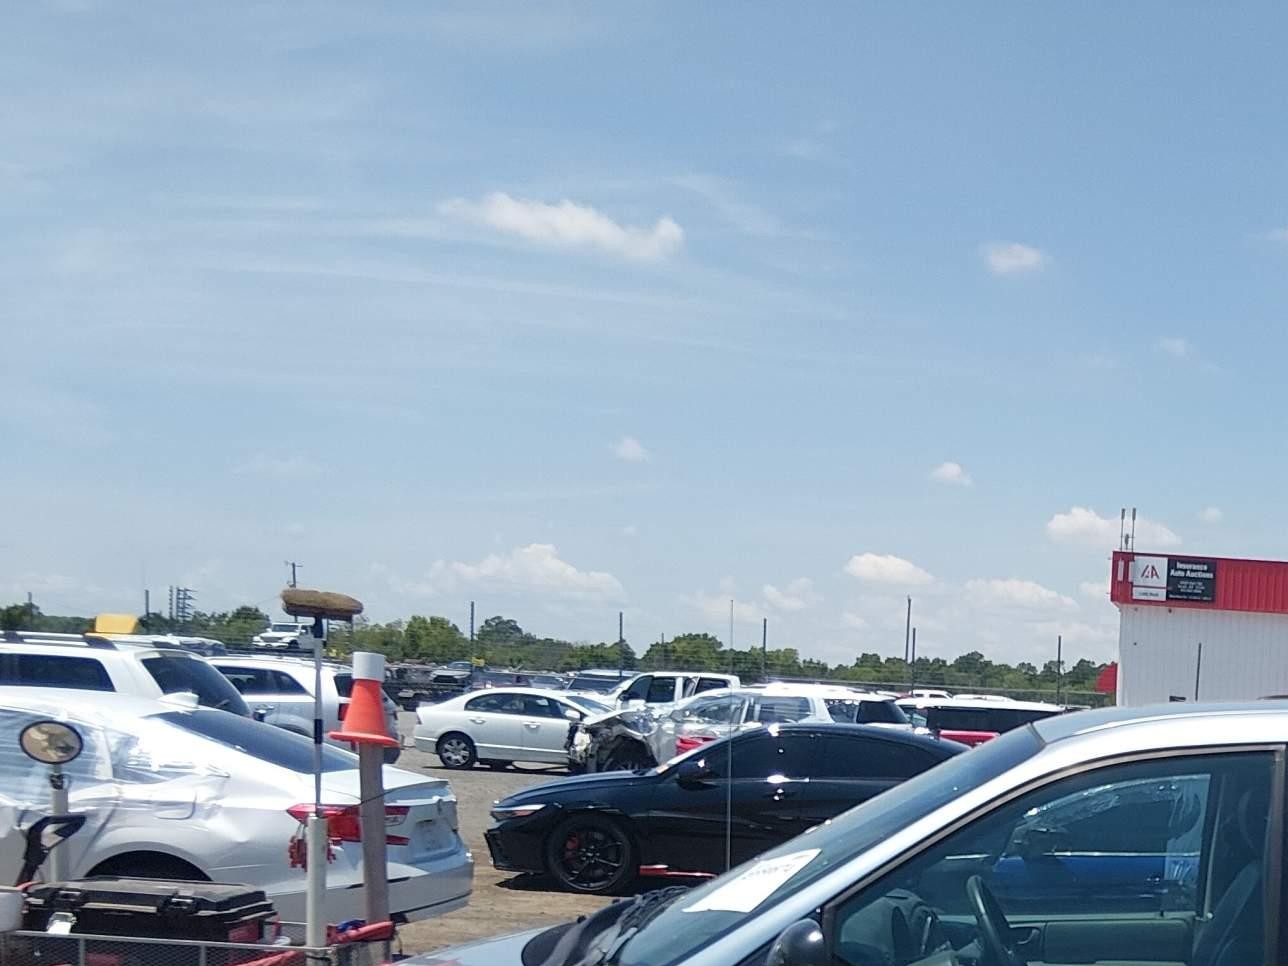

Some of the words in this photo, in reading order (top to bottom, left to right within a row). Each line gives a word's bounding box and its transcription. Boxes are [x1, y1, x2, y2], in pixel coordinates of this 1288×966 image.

[1176, 561, 1208, 571] Insurance
[1170, 569, 1185, 577] Auto
[1186, 570, 1214, 579] Auctions
